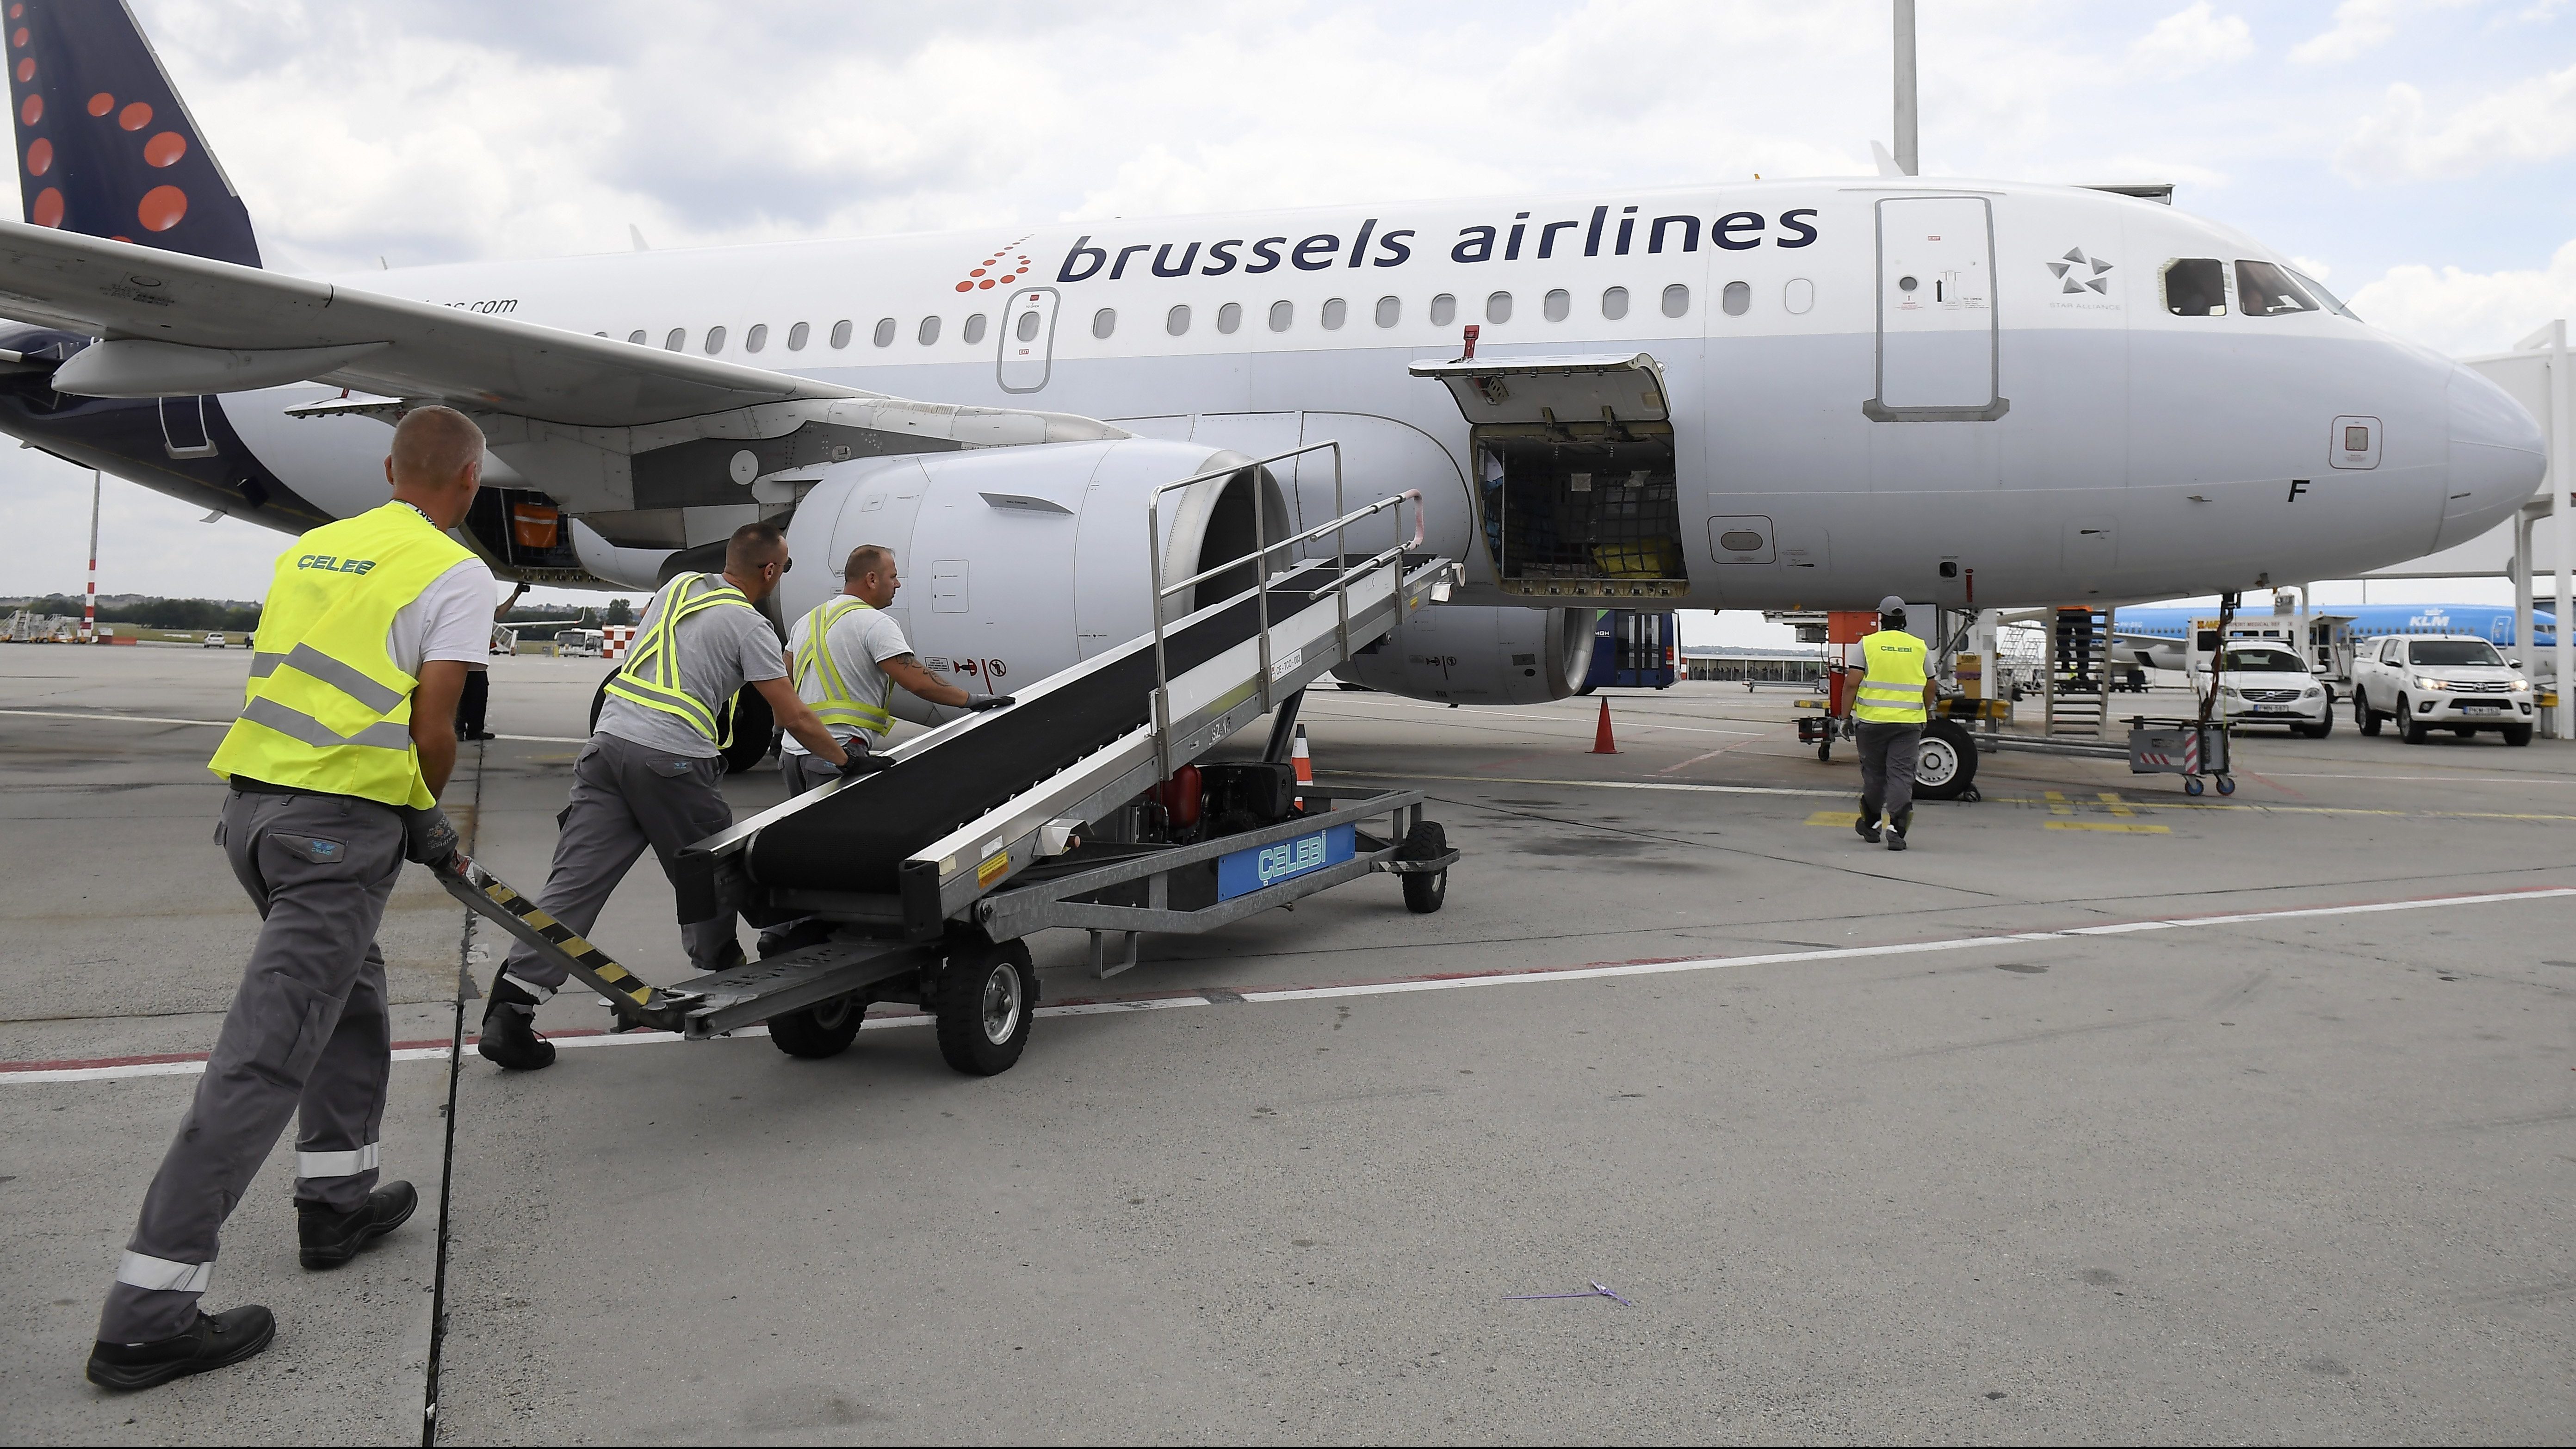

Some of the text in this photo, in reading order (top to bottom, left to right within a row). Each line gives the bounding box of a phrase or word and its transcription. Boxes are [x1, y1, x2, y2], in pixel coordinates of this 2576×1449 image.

[1056, 205, 1818, 283] brussels airlines
[2286, 479, 2311, 503] F
[2409, 616, 2450, 626] KLM
[1258, 830, 1326, 886] ÇELEBİ
